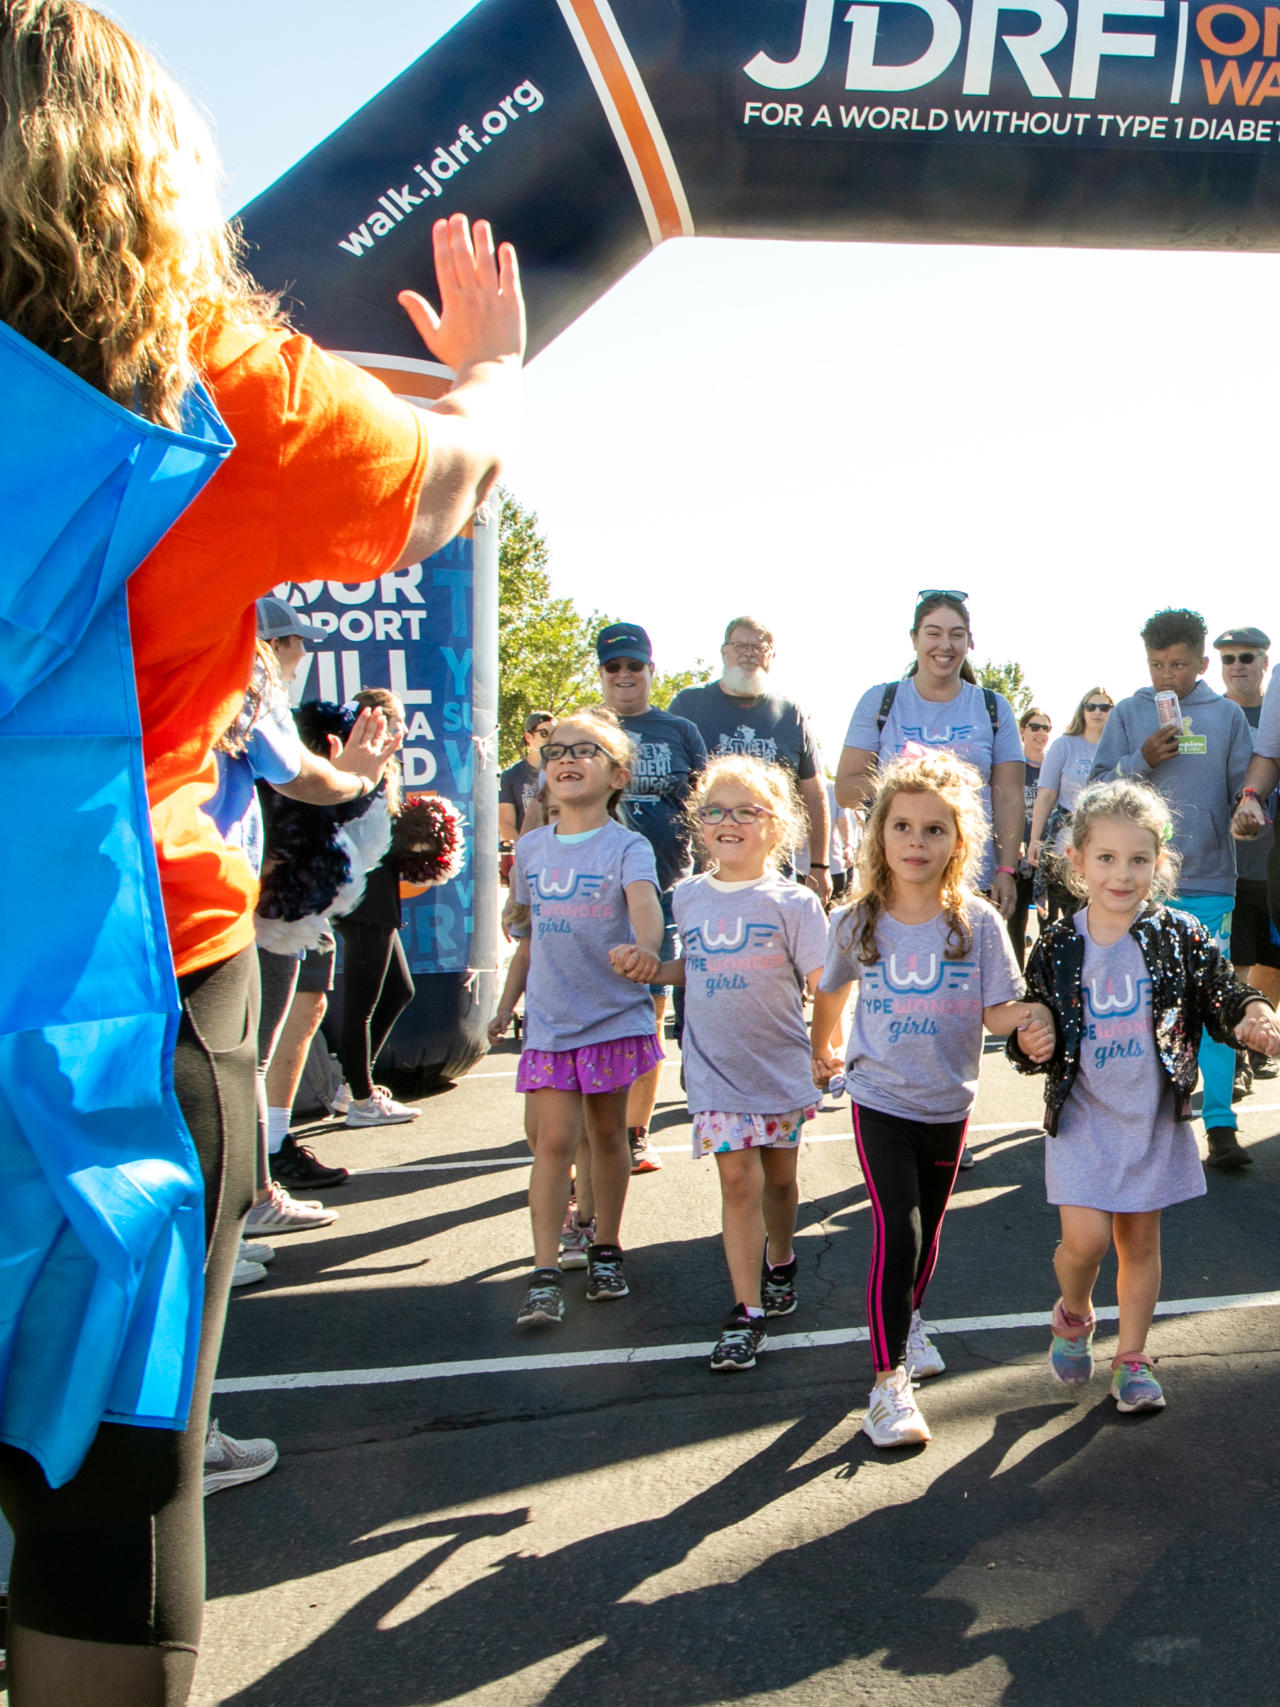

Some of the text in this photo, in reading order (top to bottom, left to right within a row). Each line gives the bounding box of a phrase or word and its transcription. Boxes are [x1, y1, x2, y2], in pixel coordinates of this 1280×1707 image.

[743, 0, 1164, 98] JDRF
[743, 102, 802, 126] FOR
[811, 105, 833, 127] A
[839, 106, 949, 131] WORLD
[954, 109, 1091, 135] WITHOUT
[1098, 115, 1168, 138] TYPE
[1174, 117, 1184, 139] 1
[338, 79, 543, 257] walk.jdrf.org
[537, 918, 573, 940] girls
[705, 973, 749, 998] girls
[888, 1016, 940, 1043] girls
[1094, 1039, 1145, 1070] girls
